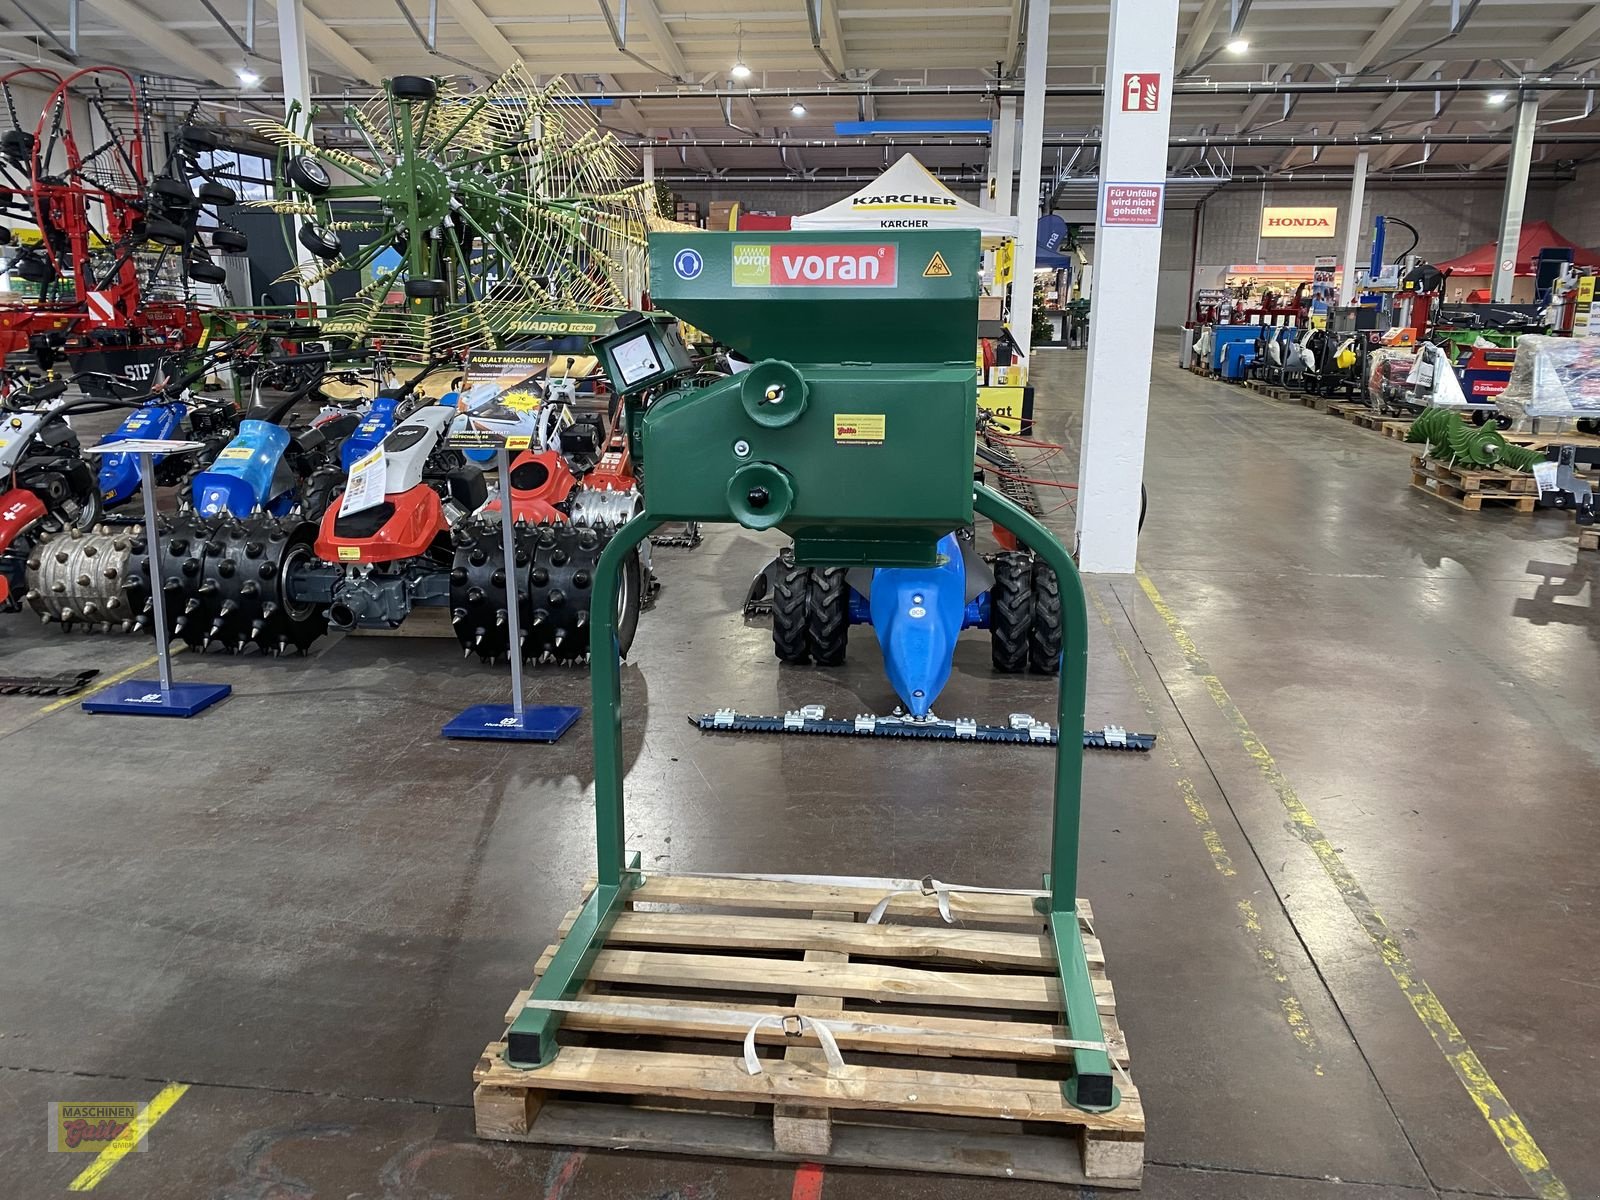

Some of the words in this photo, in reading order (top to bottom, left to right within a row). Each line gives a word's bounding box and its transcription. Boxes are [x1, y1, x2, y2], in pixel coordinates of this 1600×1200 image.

[1110, 188, 1125, 197] Für
[1126, 189, 1158, 198] Unfälle
[853, 195, 957, 206] KÄRCHER
[1111, 198, 1131, 206] wird
[1132, 198, 1156, 207] nicht
[1113, 207, 1152, 217] gehaftet
[880, 219, 929, 228] KÄRCHER
[1268, 218, 1330, 226] HONDA
[734, 254, 770, 265] voran
[781, 255, 880, 280] voran
[509, 321, 568, 332] SWADRO
[124, 363, 151, 381] SIP
